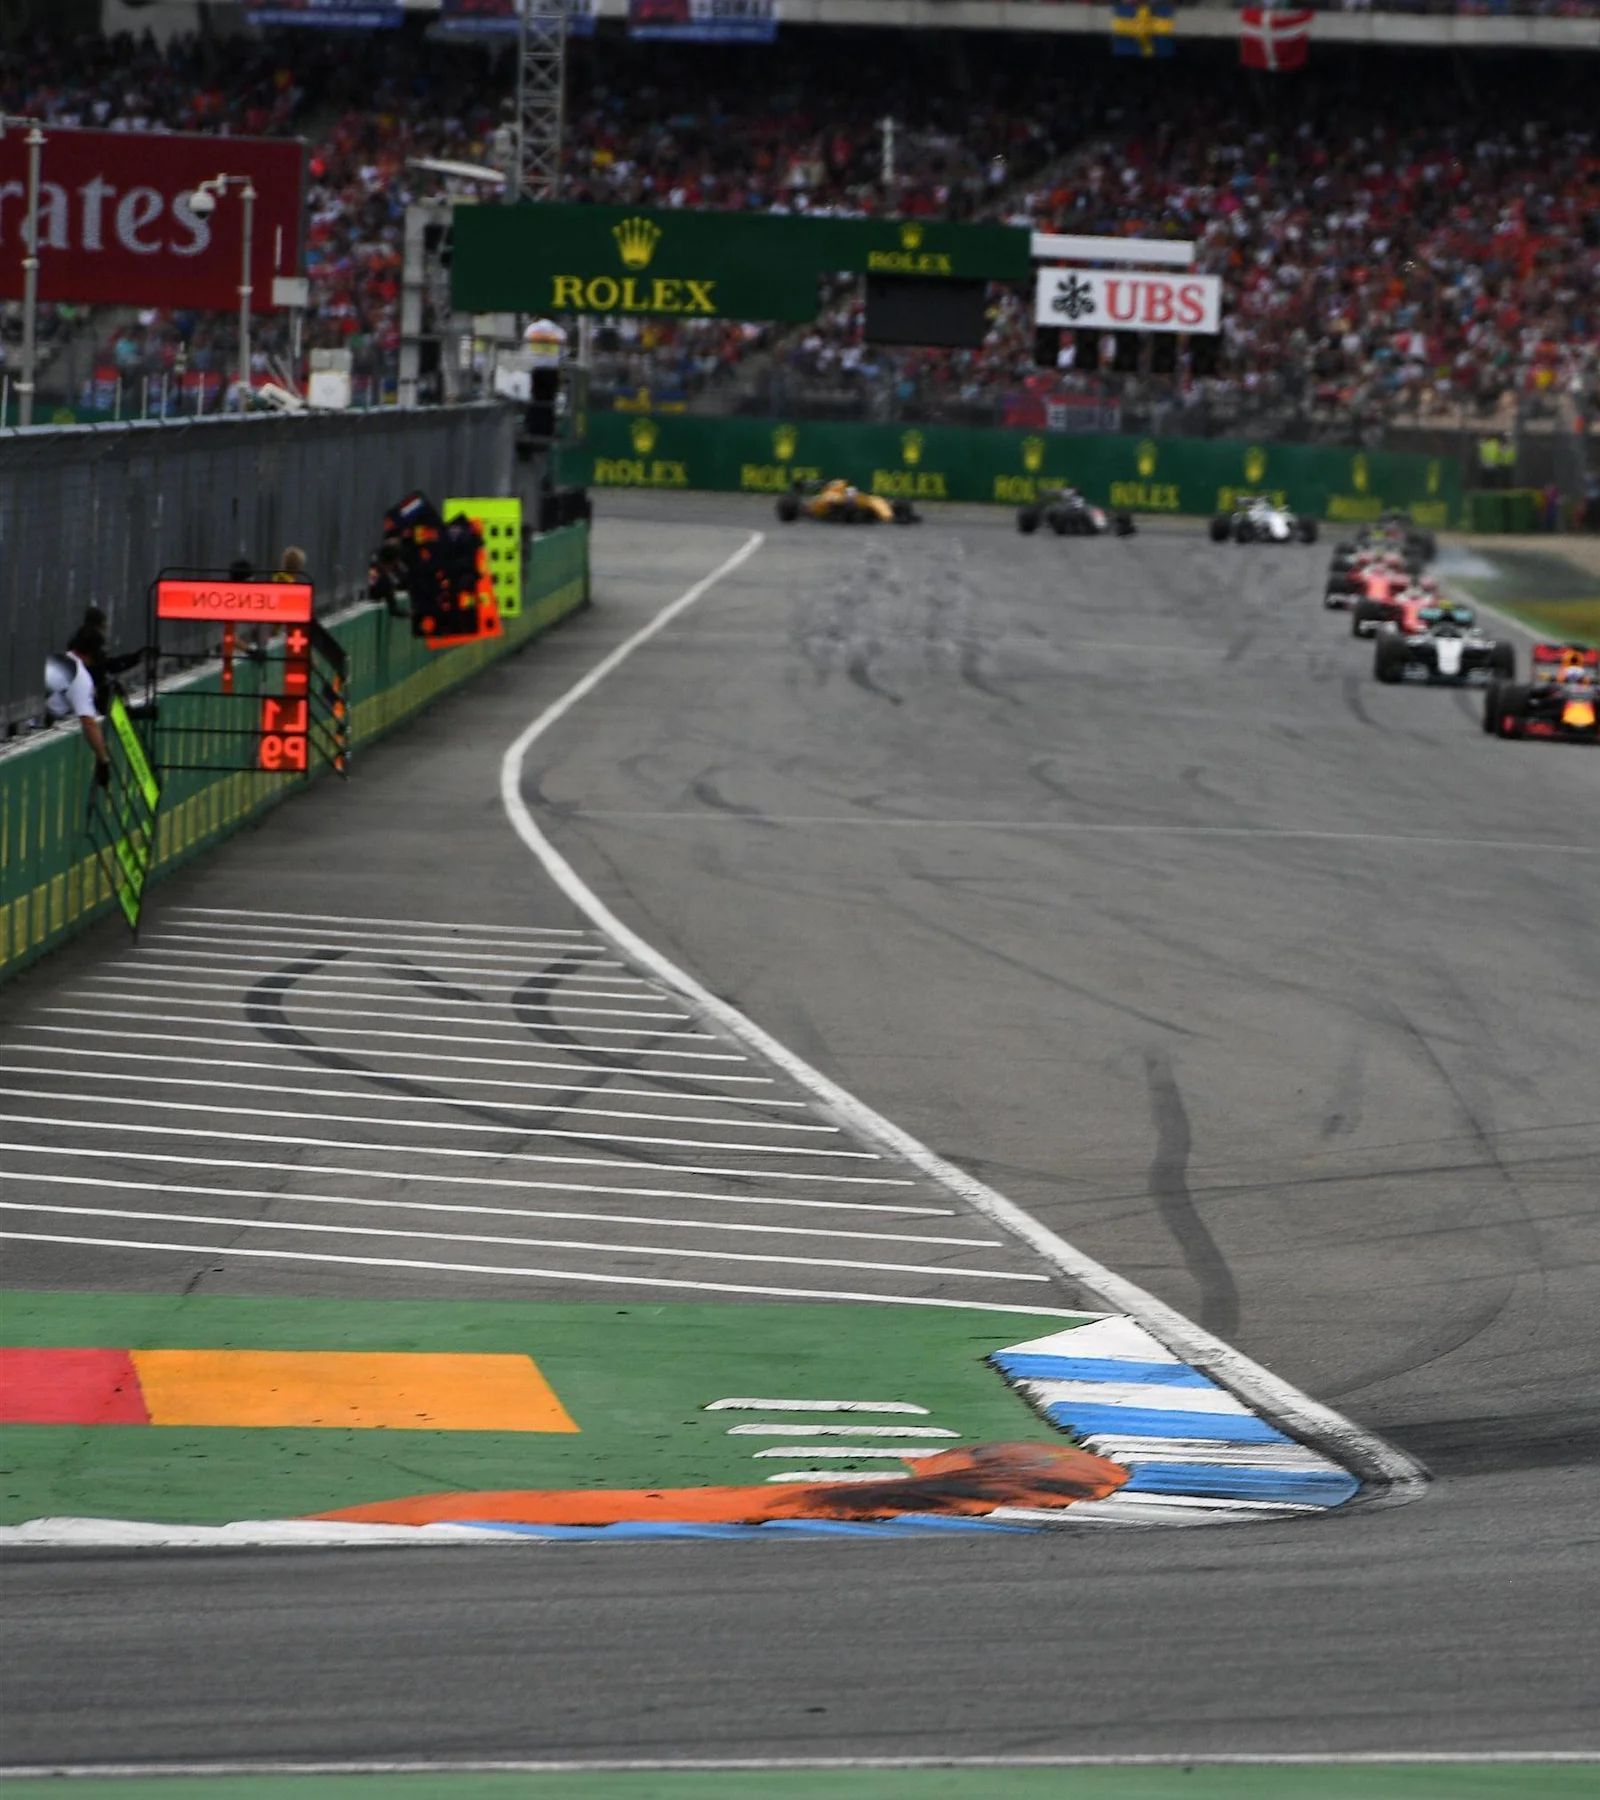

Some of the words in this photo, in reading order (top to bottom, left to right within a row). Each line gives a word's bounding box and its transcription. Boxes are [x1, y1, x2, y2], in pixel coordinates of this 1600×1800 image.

[868, 251, 951, 276] ROLEX
[552, 275, 717, 313] ROLEX
[1104, 279, 1206, 325] UBS
[594, 457, 688, 488] ROLEX
